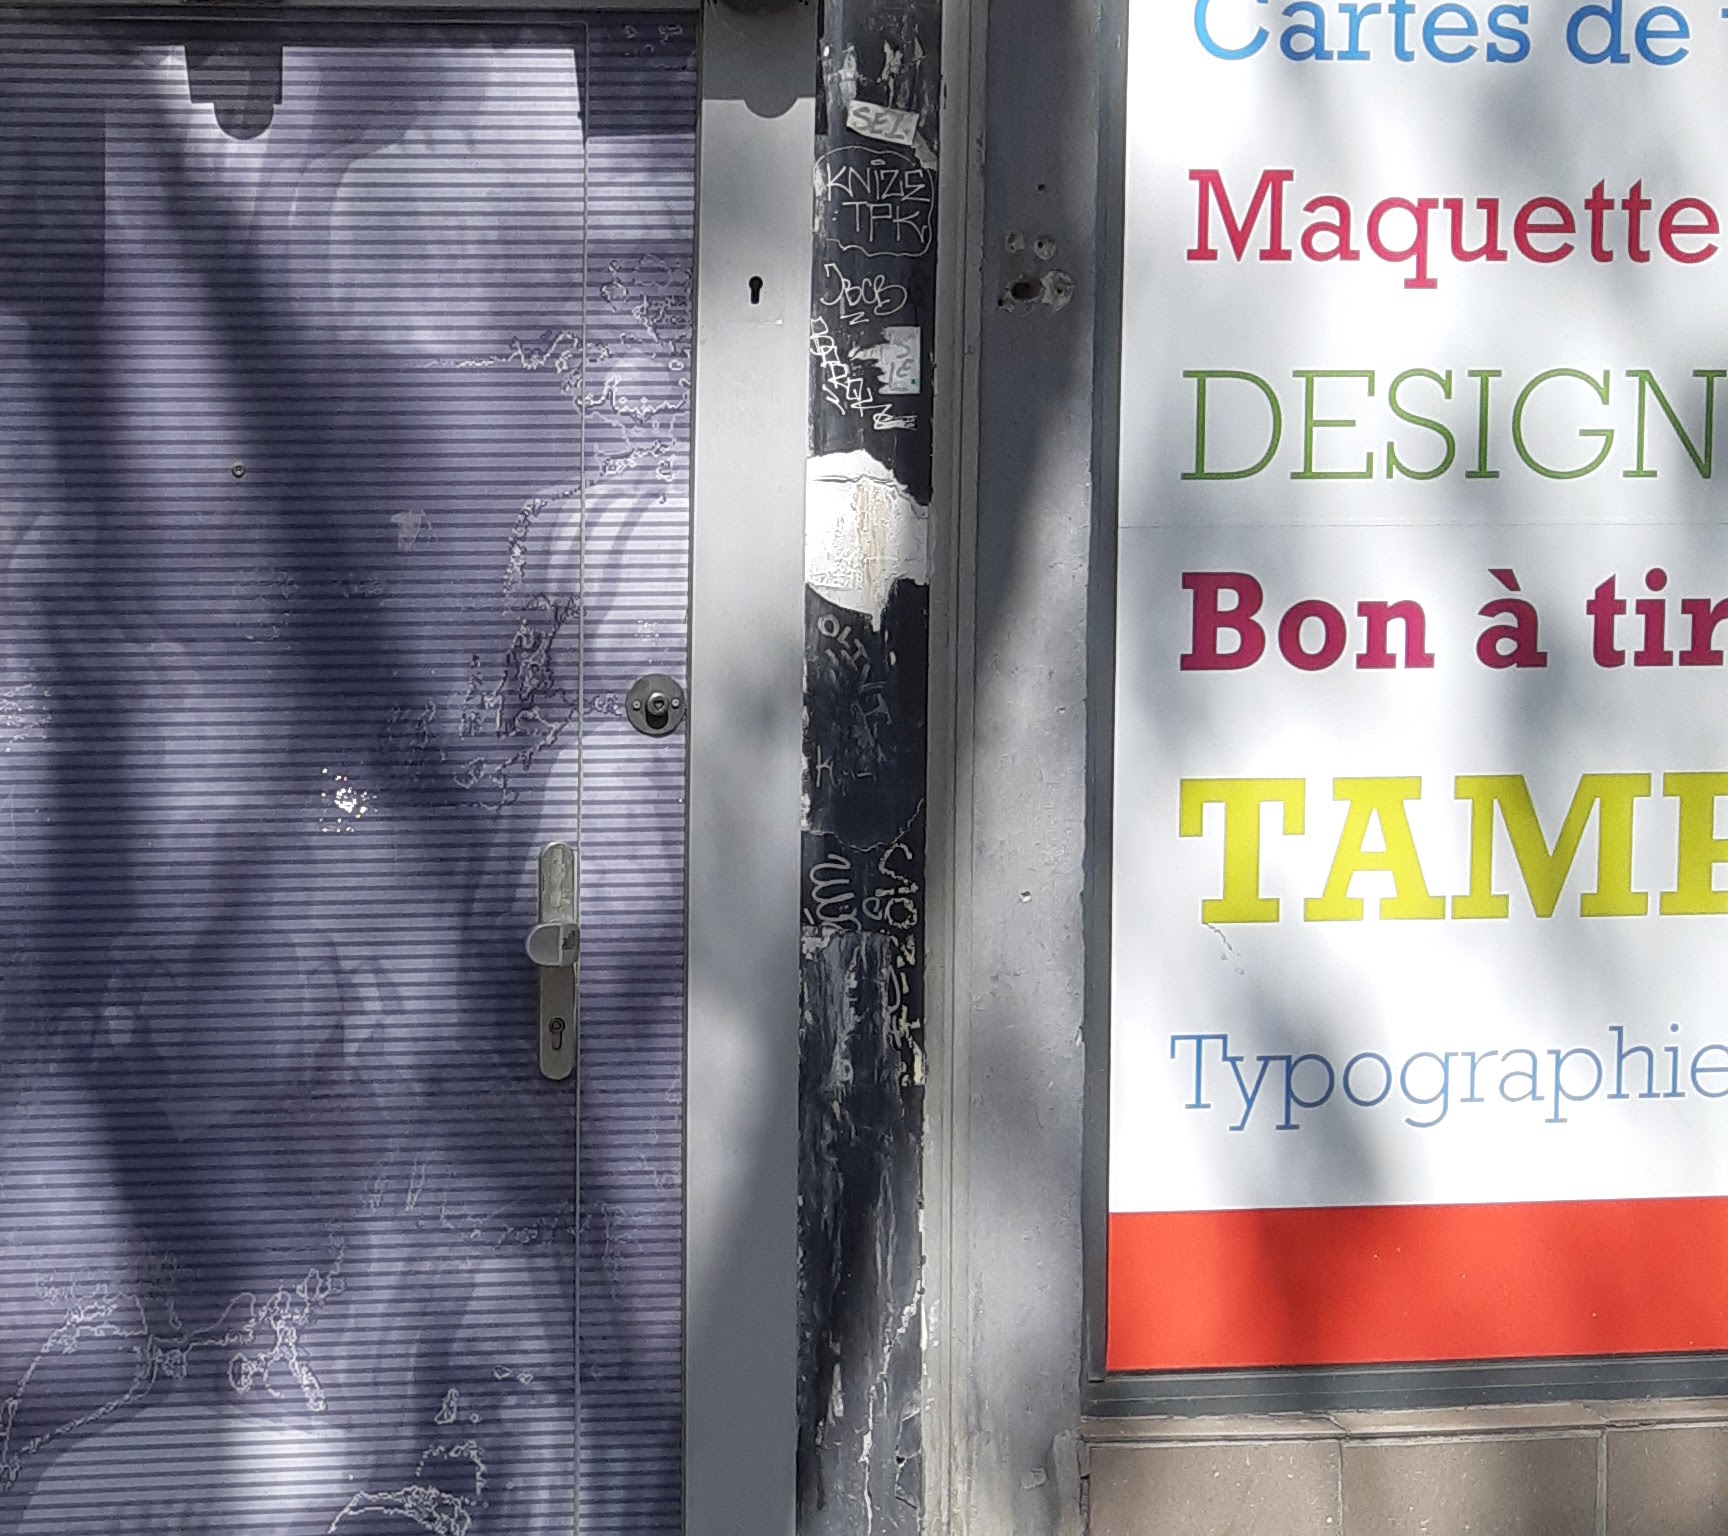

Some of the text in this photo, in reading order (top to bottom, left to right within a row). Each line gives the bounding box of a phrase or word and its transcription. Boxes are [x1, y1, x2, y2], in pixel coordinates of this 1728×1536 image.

[1186, 168, 1720, 290] Maquette
[1181, 368, 1728, 481] DESIGN
[1180, 571, 1435, 672] Bon
[1476, 568, 1548, 670] à
[1170, 1022, 1728, 1131] Typographie
